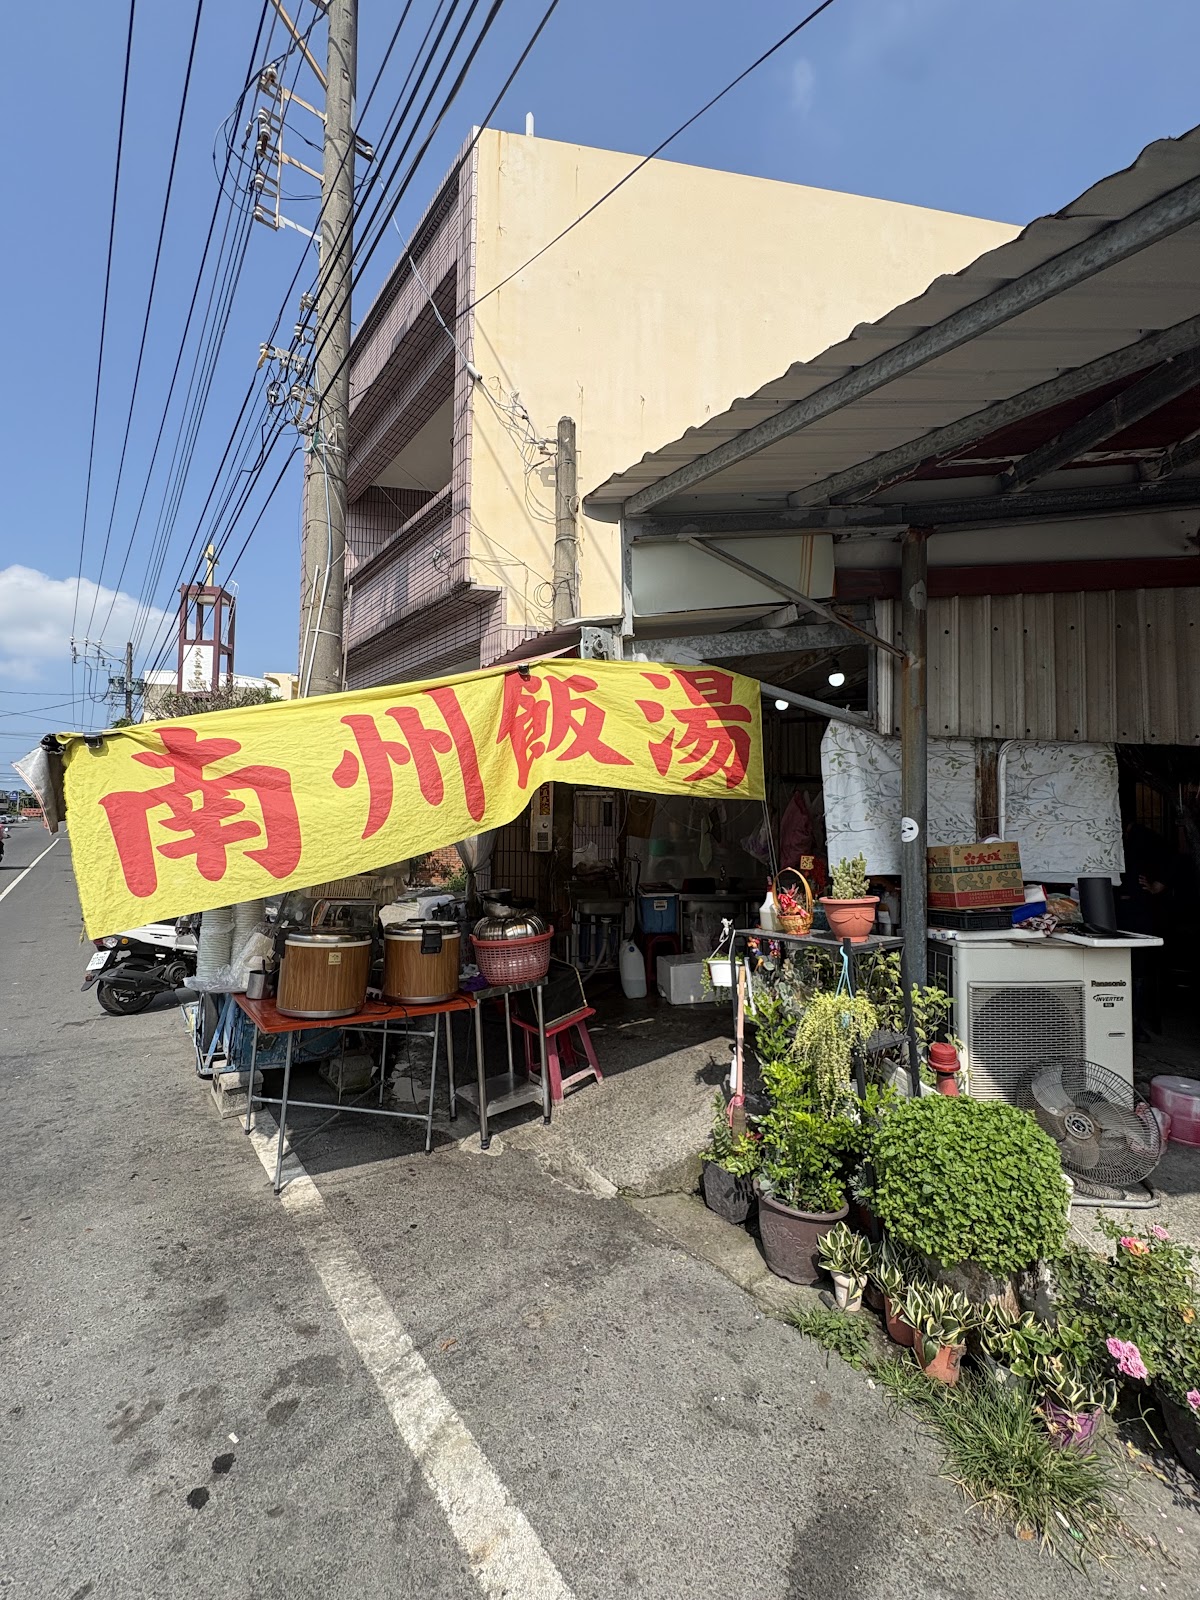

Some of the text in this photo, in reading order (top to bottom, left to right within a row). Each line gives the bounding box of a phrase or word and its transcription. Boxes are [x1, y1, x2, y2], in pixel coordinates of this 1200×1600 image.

[99, 669, 751, 897] 南州飯湯
[976, 849, 1002, 865] 大成
